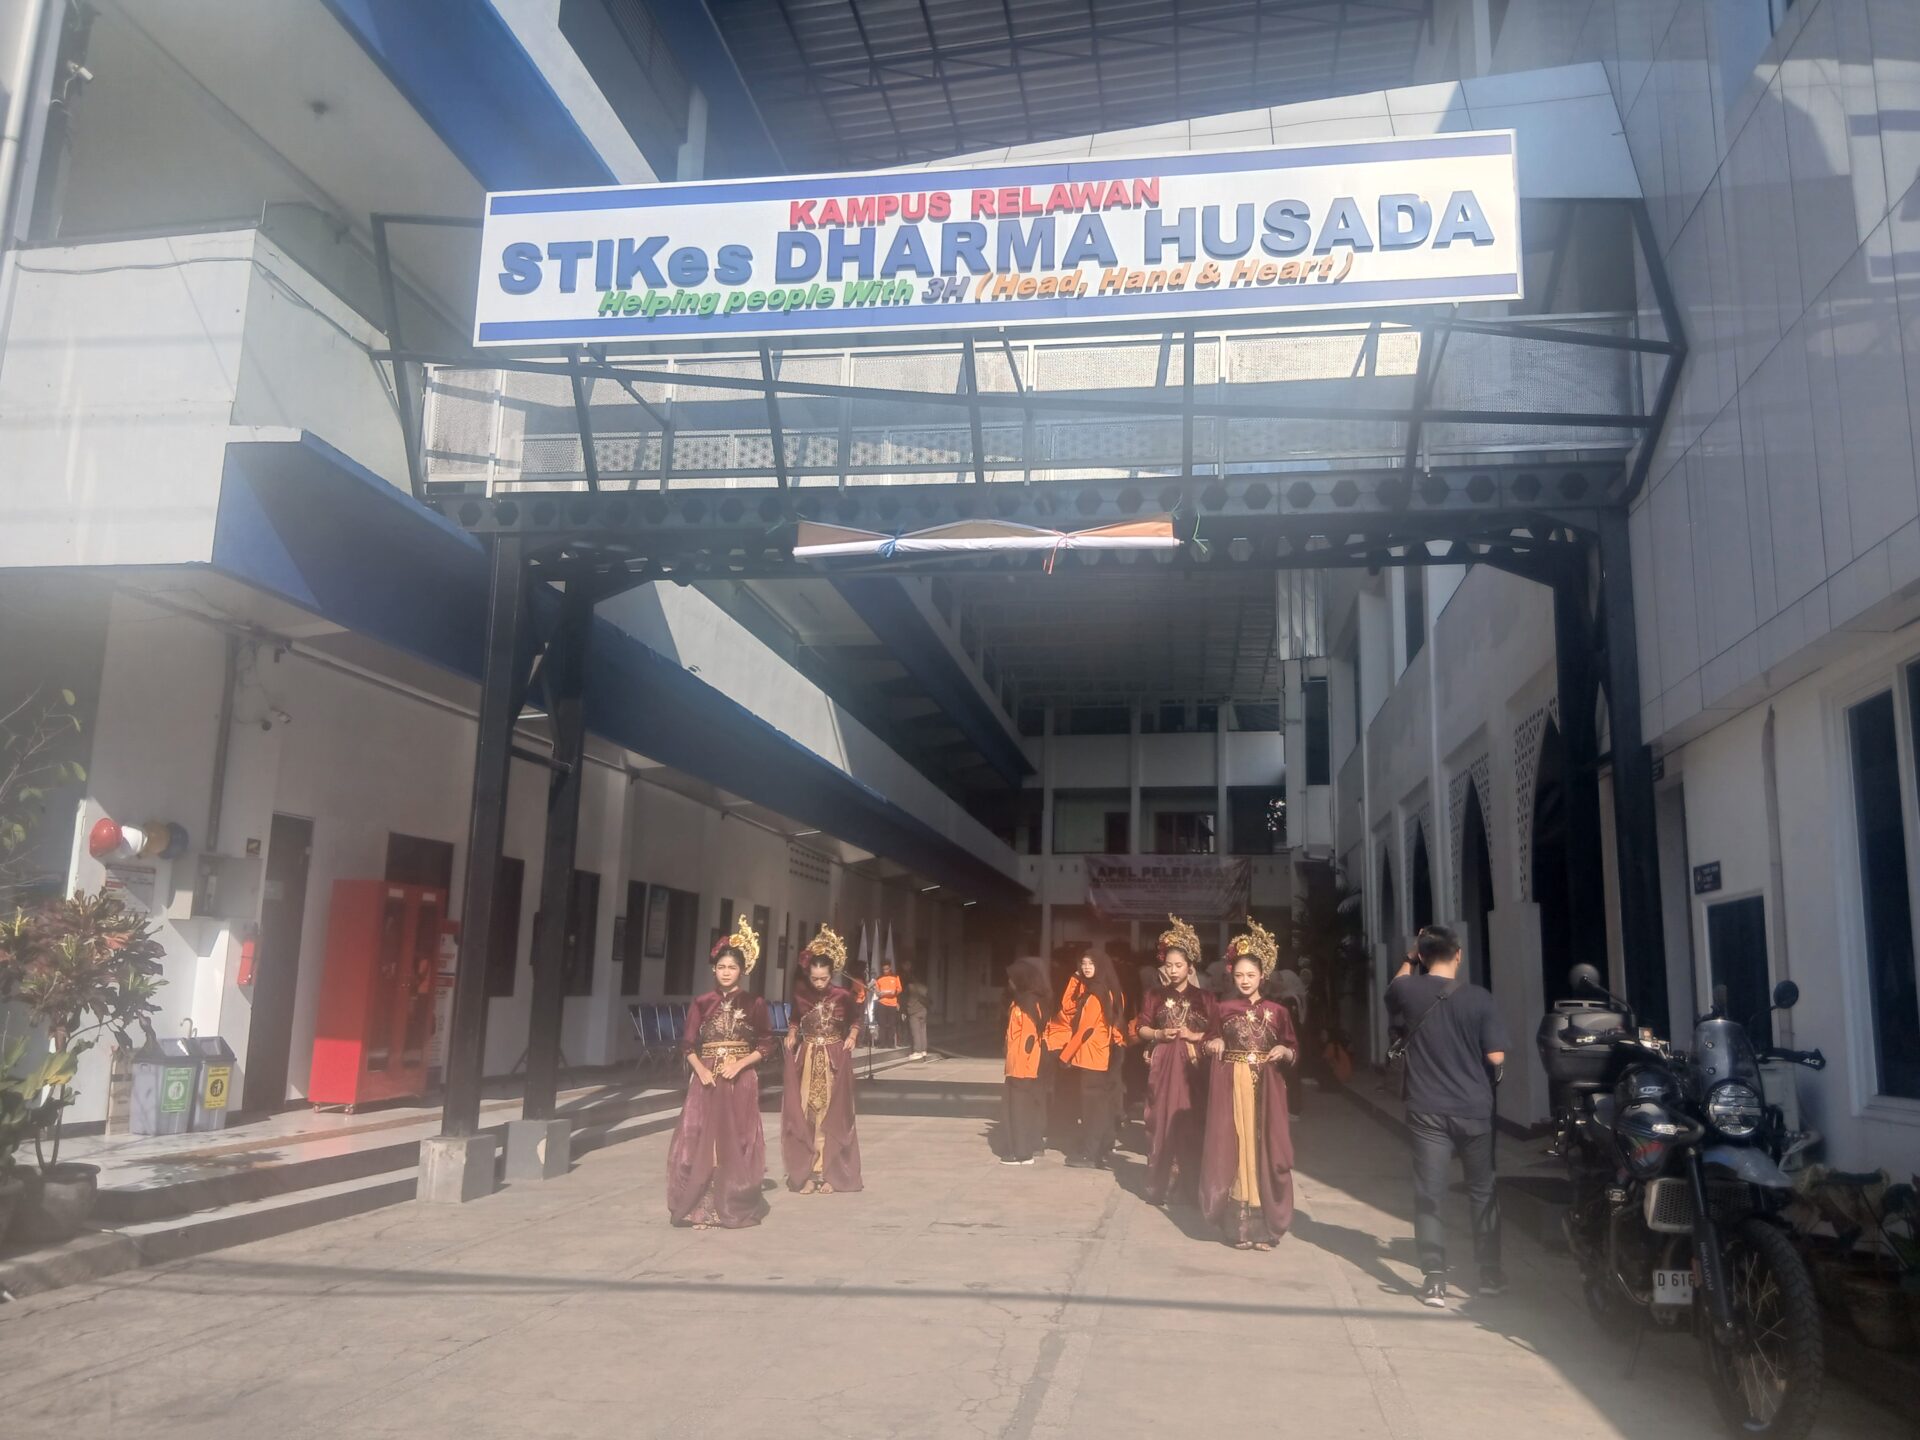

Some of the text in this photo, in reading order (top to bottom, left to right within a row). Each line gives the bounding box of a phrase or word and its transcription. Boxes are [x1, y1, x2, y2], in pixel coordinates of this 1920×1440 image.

[790, 177, 1160, 230] KAMPUS RELAWAN
[498, 190, 1495, 295] STIKes DHARMA HUSADA
[598, 288, 721, 321] Helping
[723, 283, 836, 318] people
[843, 279, 915, 307] With
[922, 276, 971, 304] 3H
[1098, 262, 1192, 296] Hand
[1195, 261, 1221, 289] &
[1097, 866, 1137, 878] APEL
[1658, 1273, 1665, 1286] D
